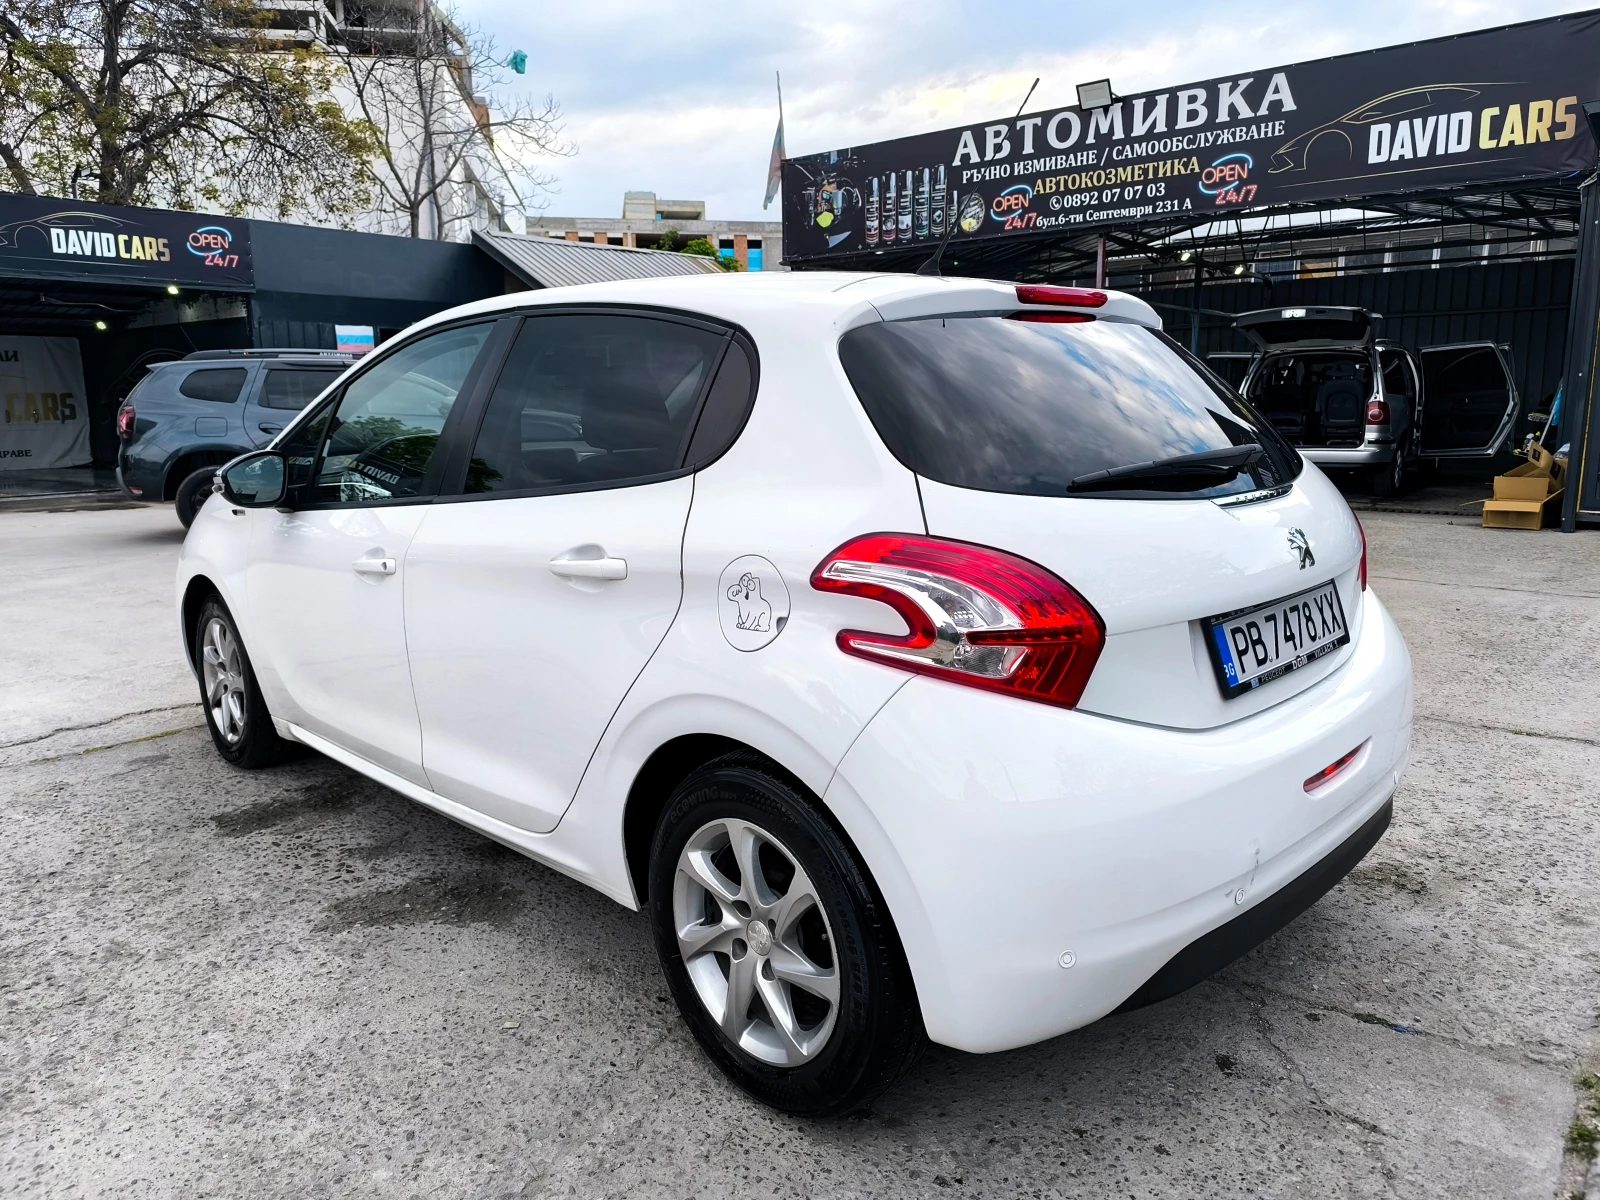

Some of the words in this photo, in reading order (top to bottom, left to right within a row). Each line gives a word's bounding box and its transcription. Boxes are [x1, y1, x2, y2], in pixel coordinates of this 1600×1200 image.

[952, 72, 1297, 166] АВТОМИВКА
[1367, 110, 1472, 164] DAVID
[1479, 96, 1577, 149] CARS
[1014, 150, 1097, 176] ИЗМИВАНЕ
[1112, 120, 1286, 160] САМООБСЛУЖВАНЕ
[1033, 156, 1201, 195] АВТОКОЗМЕТИКА
[1202, 163, 1248, 184] OPEN
[993, 193, 1029, 212] OPEN
[1063, 191, 1099, 208] 0892
[1102, 187, 1121, 203] 07
[1124, 185, 1143, 201] 07
[1146, 182, 1166, 197] 03
[1216, 184, 1257, 205] 24/7
[1004, 213, 1037, 230] 24/7
[1086, 203, 1153, 221] Септември
[1156, 200, 1179, 213] 231
[50, 227, 116, 258] DAVID
[118, 235, 171, 262] CARS
[188, 232, 229, 249] OPEN
[204, 252, 239, 268] 24/7
[5, 392, 77, 423] CARS
[1230, 620, 1268, 675] PB
[1264, 601, 1317, 660] 7478
[1313, 590, 1341, 638] XX
